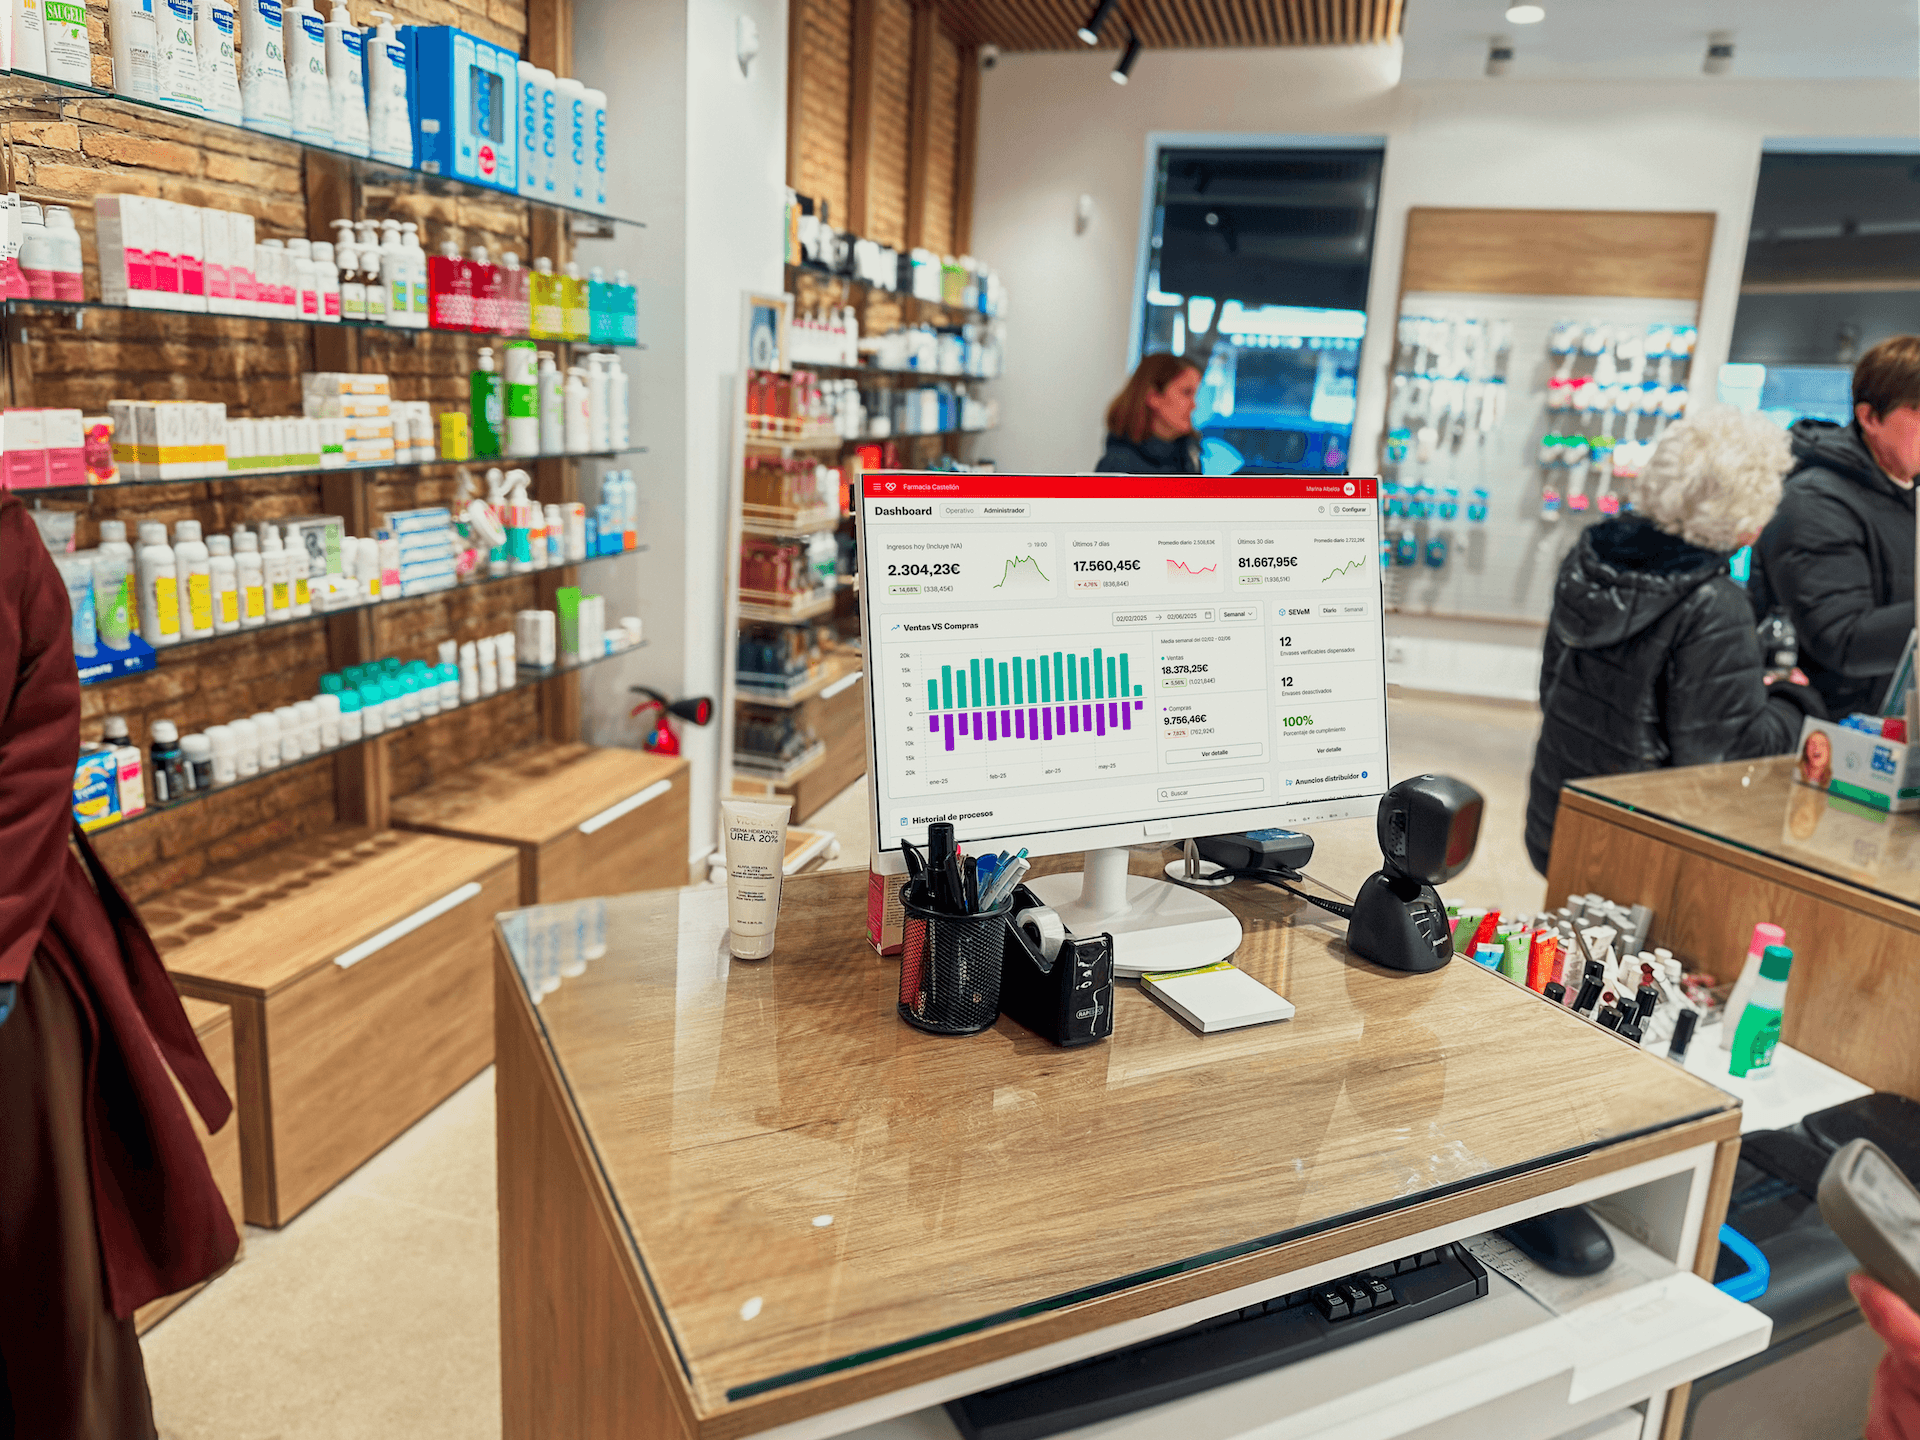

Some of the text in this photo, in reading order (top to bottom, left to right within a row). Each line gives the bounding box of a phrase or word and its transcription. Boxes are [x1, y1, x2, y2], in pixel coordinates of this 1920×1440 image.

[903, 483, 960, 491] Farmacia Castellón
[874, 506, 933, 516] Dashboard
[945, 507, 975, 515] Operativo
[1341, 506, 1367, 514] Configurar
[886, 542, 963, 551] Ingresos hoy (Incluye IVA)
[1072, 540, 1093, 548] Últimos
[1073, 559, 1141, 573] 17.560,45€
[1238, 556, 1298, 569] 81.667,95€
[887, 563, 961, 577] 2.304,23€
[1103, 580, 1129, 588] (836,84€)
[923, 585, 954, 593] (338,45€)
[1288, 608, 1310, 616] SEVeM
[1116, 614, 1148, 622] 02/02/2025
[1166, 613, 1197, 621] 02/06/2025
[903, 622, 979, 632] Ventas VS Compras
[1279, 636, 1292, 647] 12
[1300, 648, 1326, 656] verificables
[1326, 646, 1356, 655] dispensados
[1161, 663, 1209, 675] 18.378,25€
[1281, 676, 1294, 687] 12
[1168, 704, 1192, 712] Compras
[1163, 714, 1207, 725] 9.756,46€
[1282, 714, 1314, 727] 100%
[1190, 727, 1215, 736] (762,92€)
[1283, 729, 1308, 737] Porcentaje
[1315, 726, 1346, 735] cumplimiento
[1045, 767, 1061, 775] abr-25
[1295, 773, 1360, 786] Anuncios distribuidor
[1170, 789, 1188, 797] Buscar
[912, 810, 994, 825] Historial de procesos
[748, 828, 780, 836] HIDRATANTE
[730, 832, 779, 844] UREA 20%
